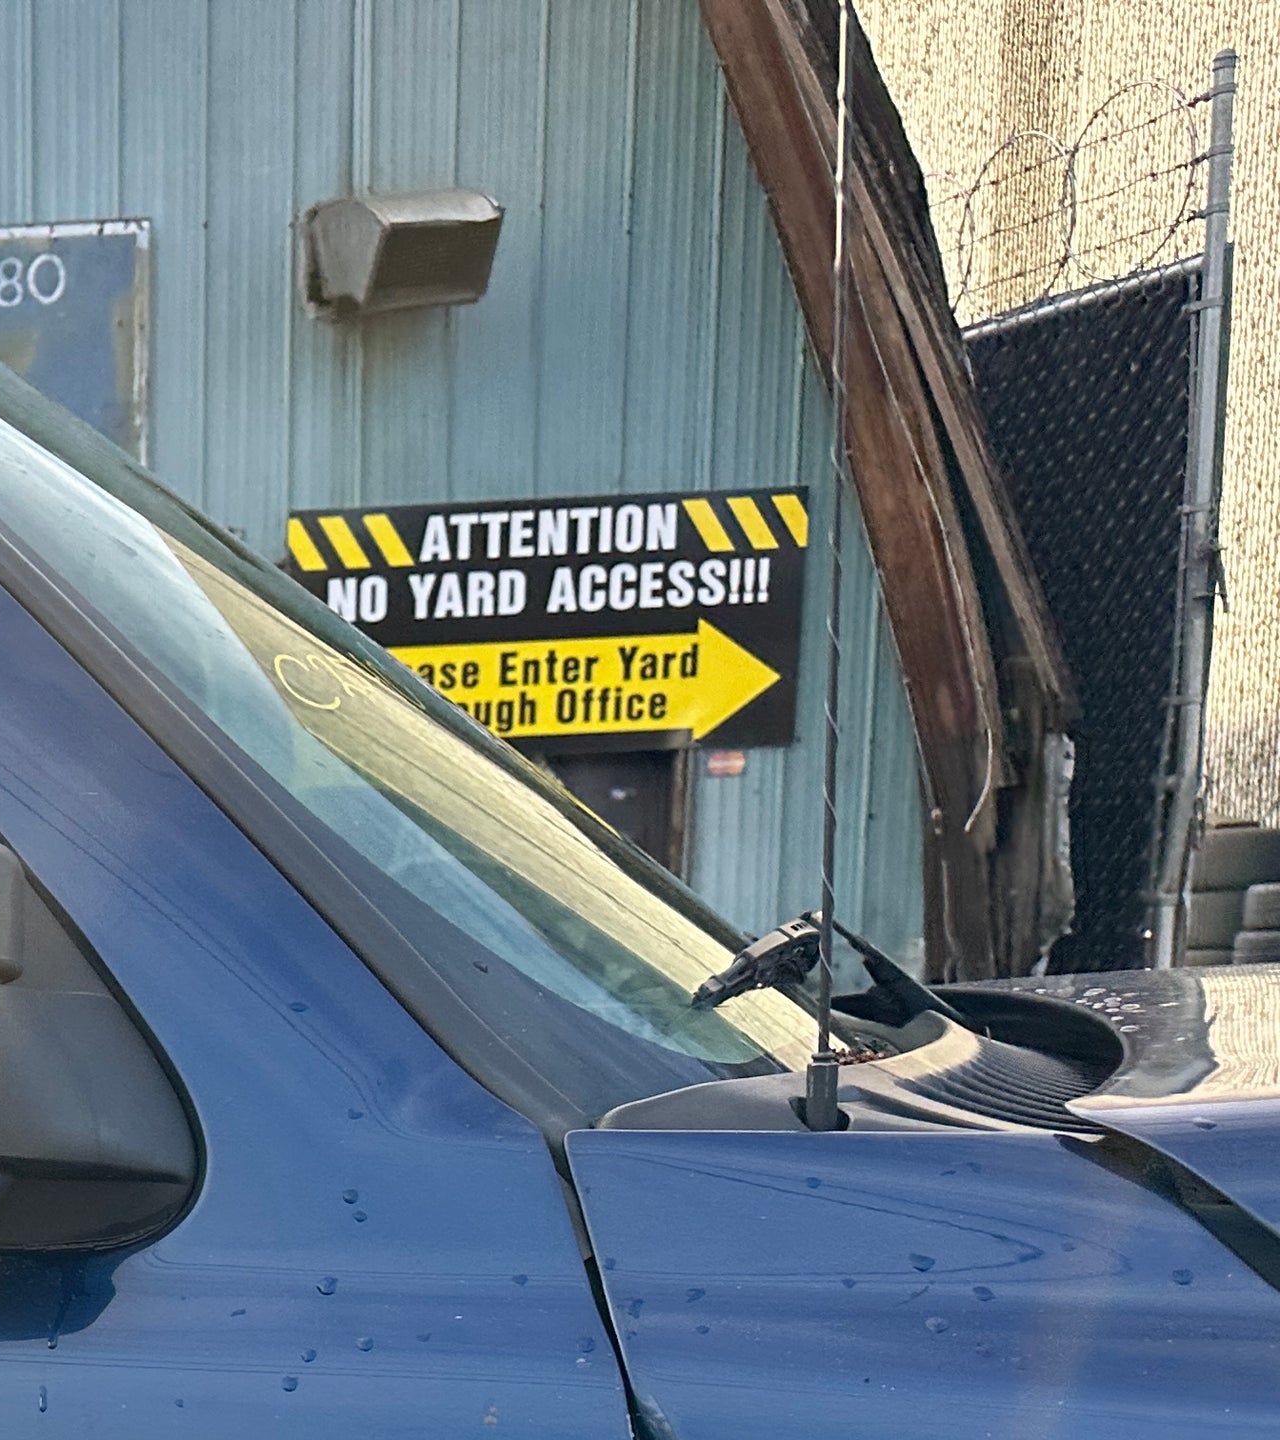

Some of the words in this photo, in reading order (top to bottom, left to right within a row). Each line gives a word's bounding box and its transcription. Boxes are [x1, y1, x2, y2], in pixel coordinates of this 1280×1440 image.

[419, 503, 678, 563] ATTENTION
[326, 575, 388, 623] NO
[409, 570, 526, 620] YARD
[546, 557, 771, 614] ACCESS!!!
[406, 661, 480, 690] ase
[500, 650, 600, 687] Enter
[619, 643, 699, 681] Yard
[556, 687, 668, 724] Office
